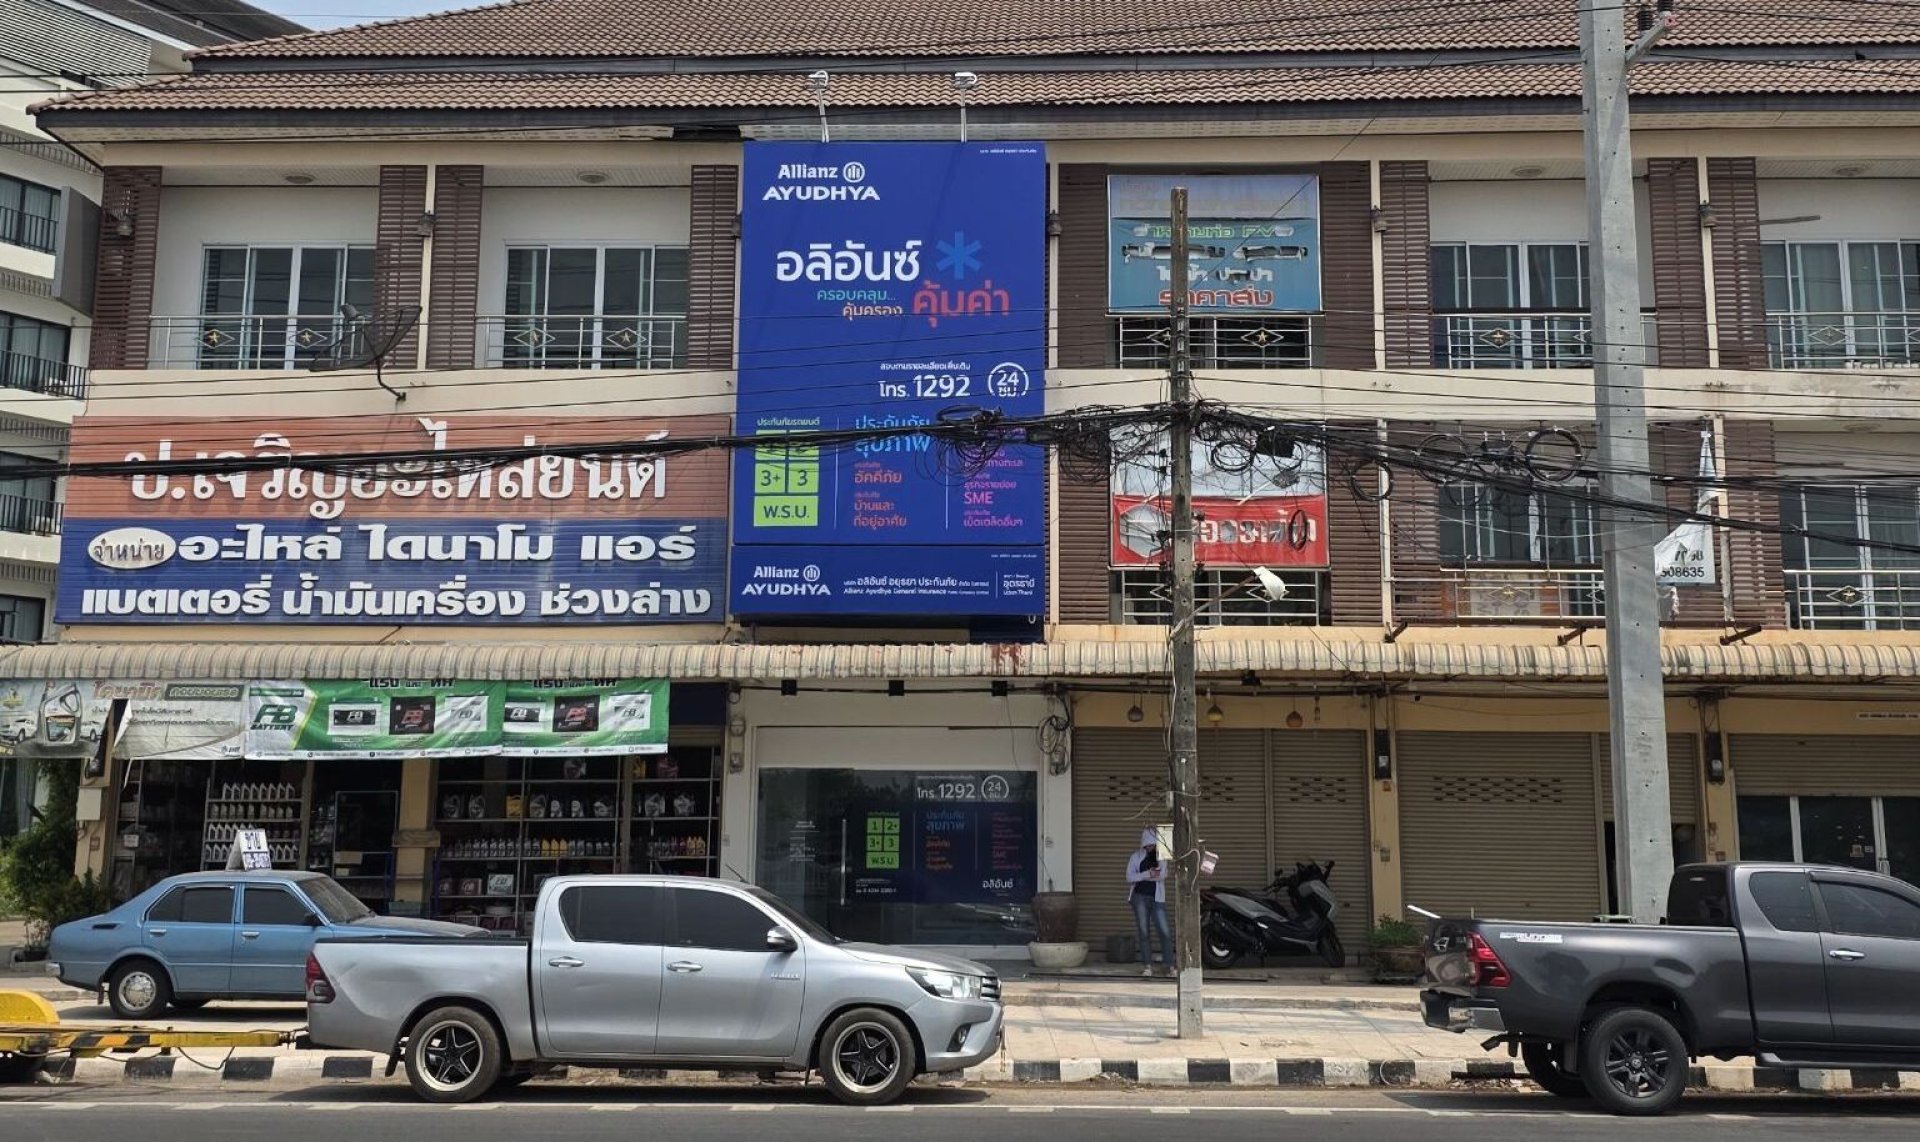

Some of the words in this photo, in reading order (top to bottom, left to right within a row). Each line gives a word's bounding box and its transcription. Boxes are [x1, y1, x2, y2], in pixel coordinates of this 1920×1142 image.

[778, 163, 838, 179] Allianz
[762, 185, 881, 201] AYUDHYA
[776, 239, 922, 282] อลิอันซ์
[817, 288, 896, 304] ครอบคลุม...
[843, 302, 903, 321] คุ้มครอง
[912, 279, 1010, 328] คุ้มค่า
[997, 370, 1019, 386] 24
[878, 381, 910, 397] โทร.
[913, 375, 971, 398] 1292
[757, 417, 820, 426] ประกันภัยรถยนต์
[761, 470, 780, 486] 3+
[797, 470, 808, 486] 3
[855, 470, 902, 484] อัคคีภัย
[854, 499, 894, 511] บ้านและ
[964, 491, 994, 505] SME
[854, 514, 907, 530] ที่อยู่อาศัย
[93, 538, 166, 562] จำหน่าย
[178, 524, 342, 561] อะไหล่
[358, 524, 553, 561] ไดนาโม
[580, 525, 697, 561] แอร์
[753, 565, 800, 578] Allianz
[741, 583, 832, 596] AYUDHYA
[857, 576, 887, 586] อลิอันซ์
[889, 578, 917, 588] อยุธยา
[918, 576, 957, 587] ประกันภัย
[1003, 578, 1035, 590] อุดรธานี
[82, 573, 272, 615] แบตเตอรี่
[283, 573, 526, 616] น้ำมันเครื่อง
[540, 581, 712, 616] ช่วงล่าง
[254, 704, 298, 723] FB
[938, 783, 976, 799] 1292
[988, 781, 1001, 792] 24
[872, 821, 877, 829] 1
[889, 839, 894, 847] 3
[982, 879, 1014, 889] อลิอันซ์
